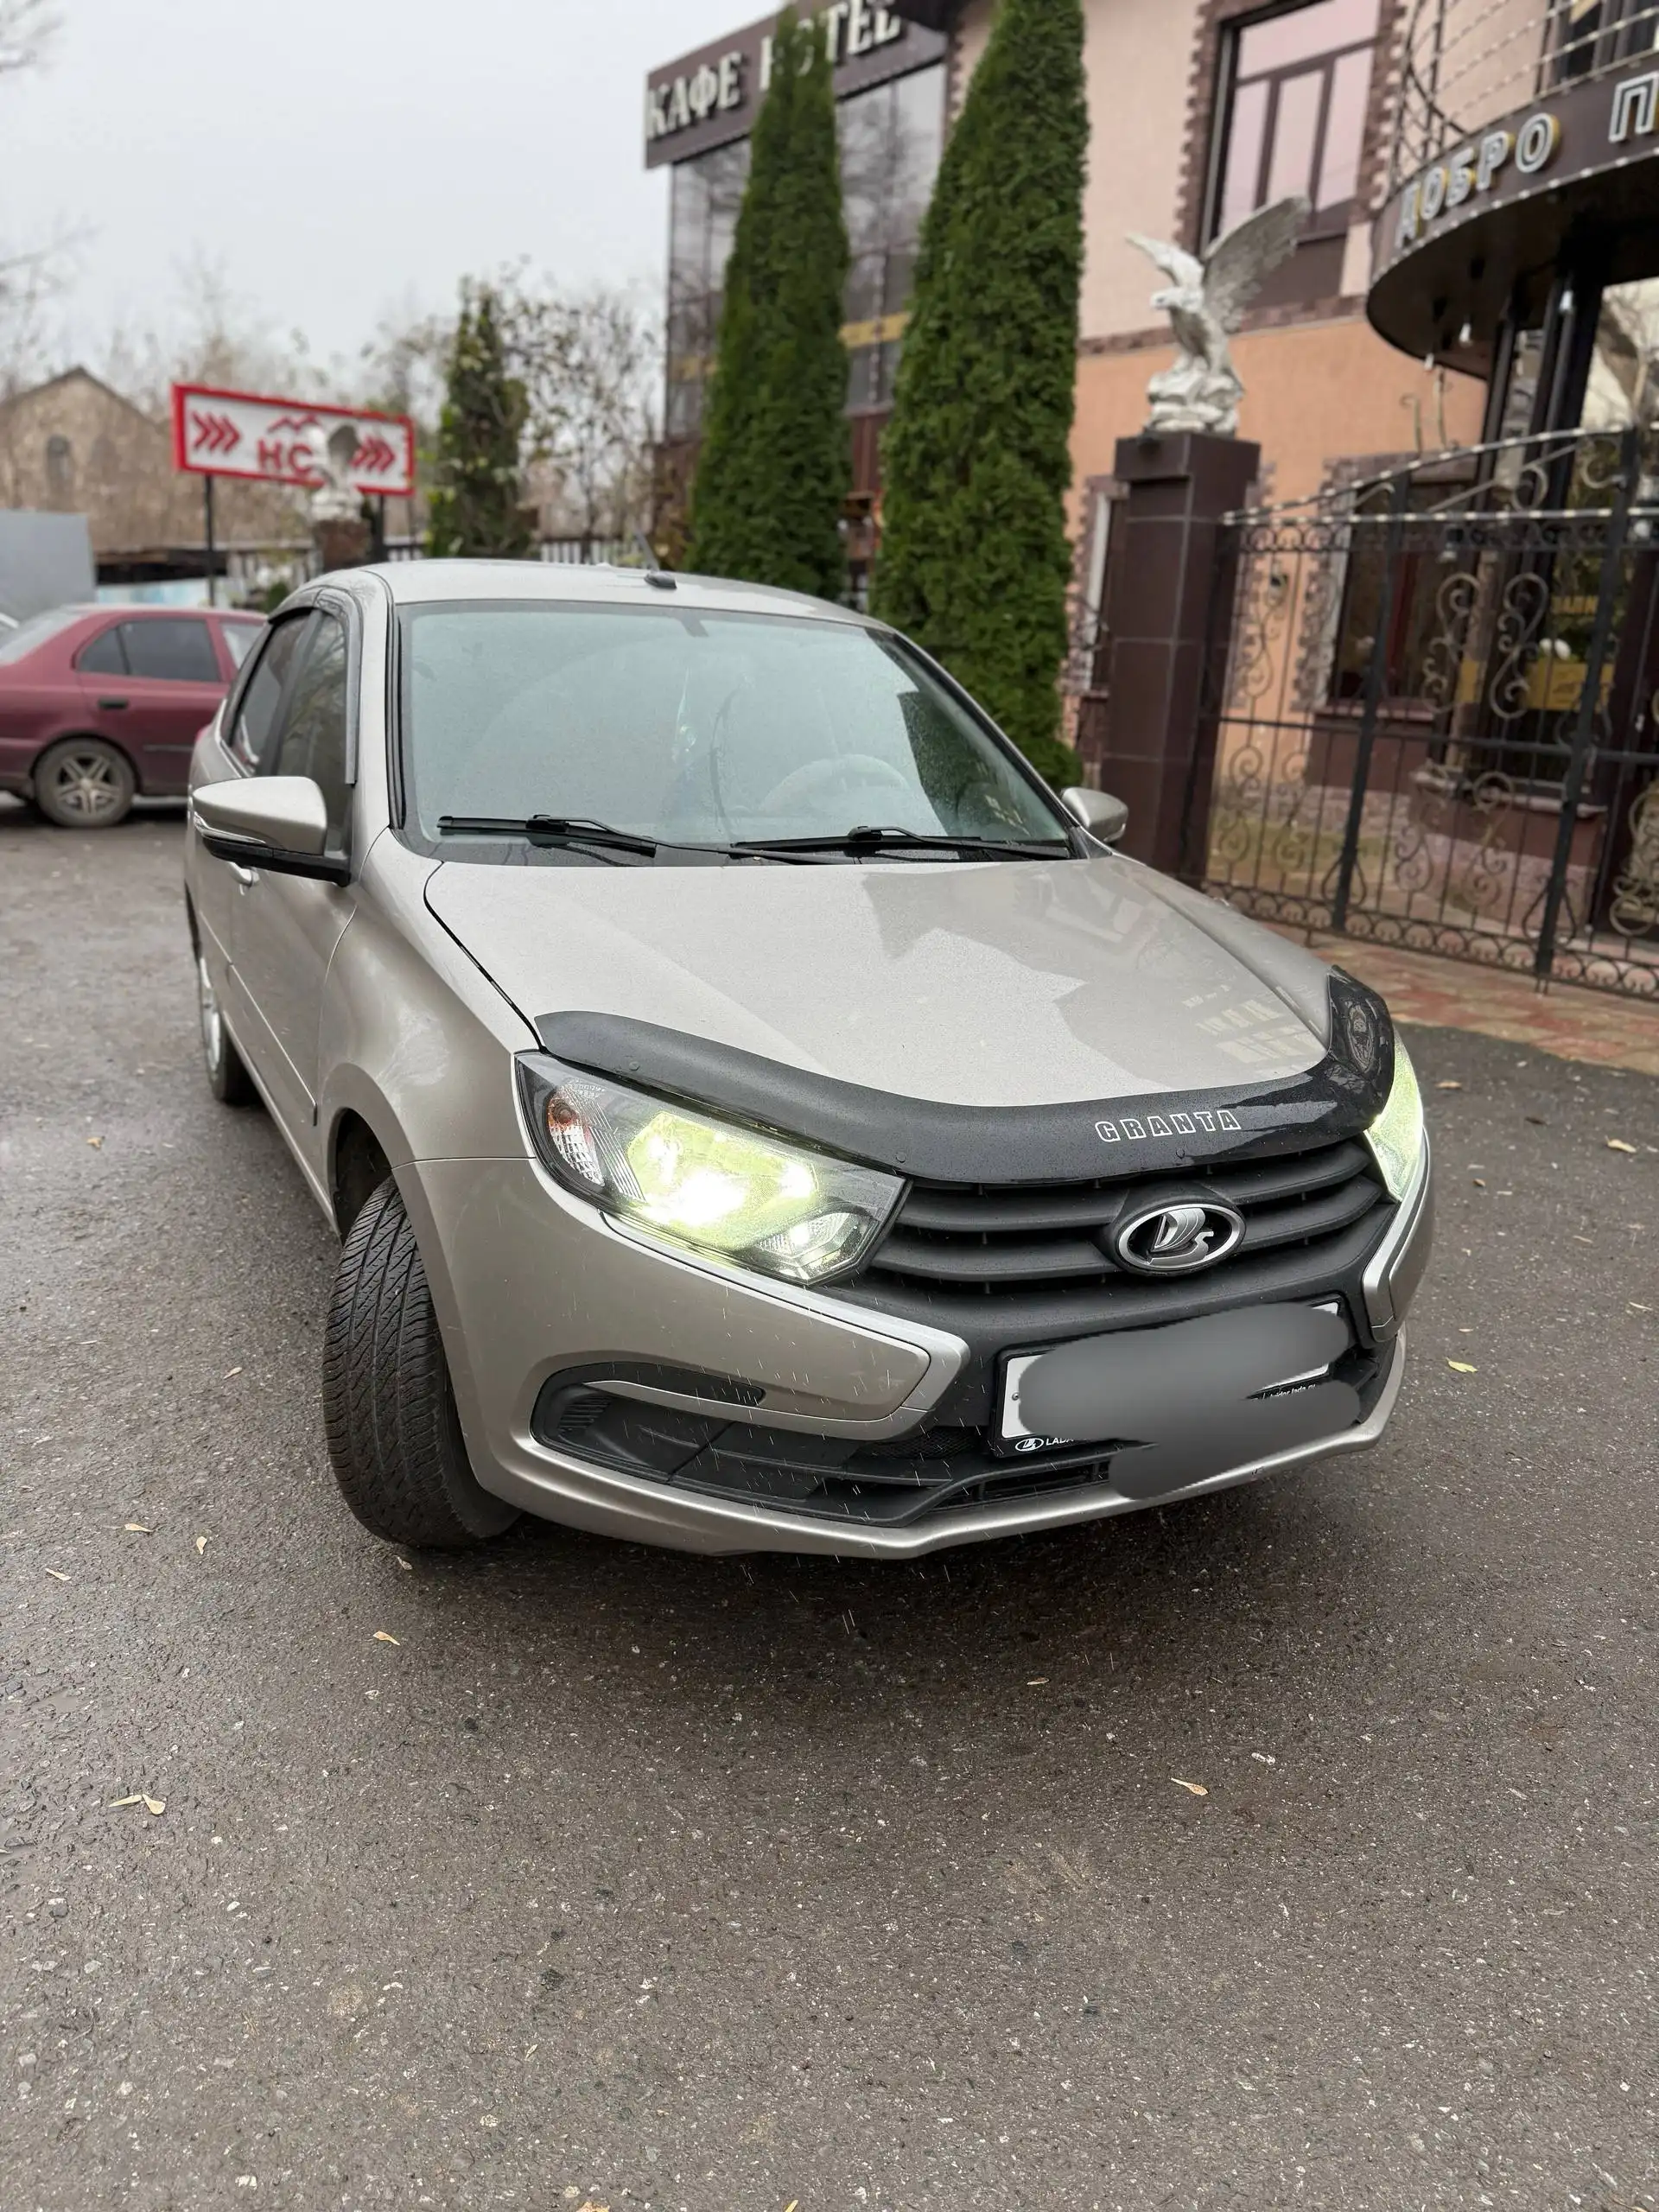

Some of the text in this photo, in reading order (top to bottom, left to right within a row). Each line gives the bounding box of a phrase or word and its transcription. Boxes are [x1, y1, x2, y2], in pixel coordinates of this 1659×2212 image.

[645, 51, 743, 140] КАФЕ
[1394, 112, 1560, 250] ДОБРО
[1094, 1109, 1242, 1143] GRANTA
